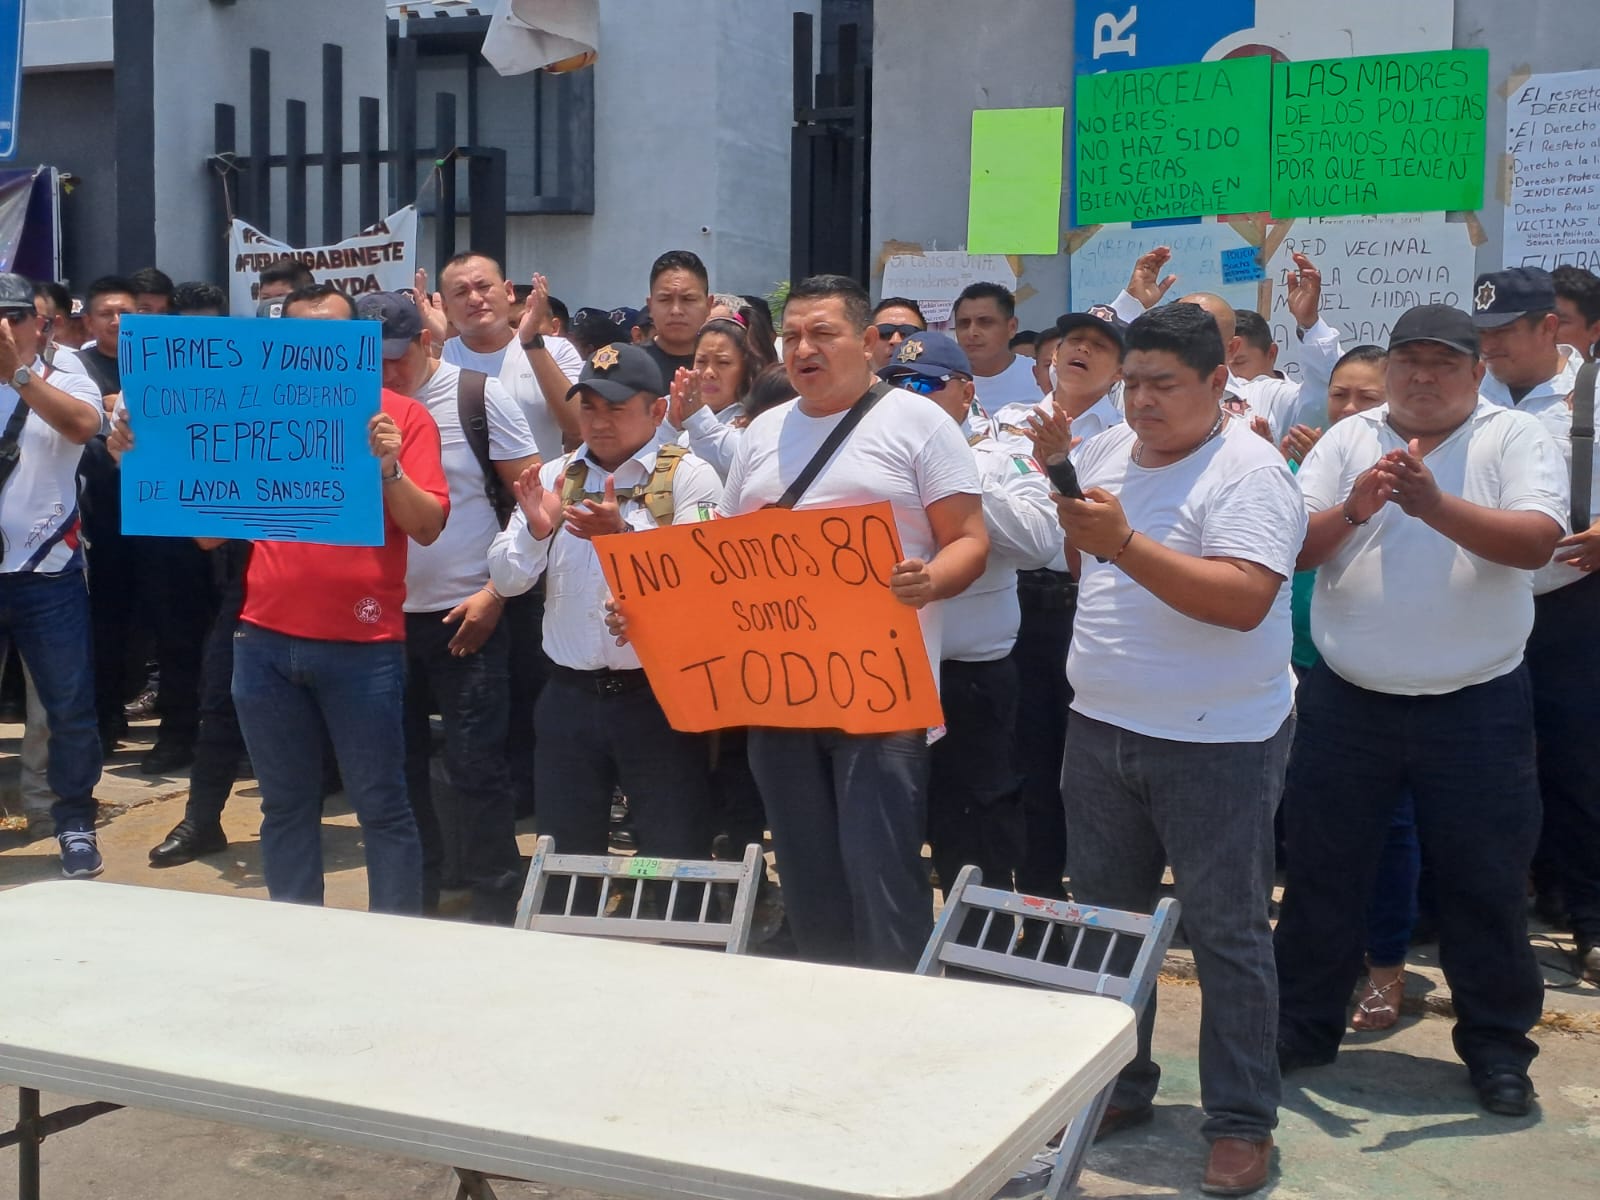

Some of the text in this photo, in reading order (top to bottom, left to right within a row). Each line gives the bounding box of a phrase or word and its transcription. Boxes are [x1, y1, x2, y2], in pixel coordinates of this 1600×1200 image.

[1094, 68, 1233, 110] MARCELA
[1285, 60, 1469, 99] LAS MADRES
[1285, 93, 1485, 126] DE LOS POLICIAS
[1077, 116, 1107, 136] NO
[1544, 119, 1597, 135] Derecho
[1080, 126, 1240, 160] NO HAZ SIDO
[1276, 127, 1477, 157] ESTAMOS AQUI
[1080, 157, 1187, 188] NI SERAS
[1276, 155, 1468, 181] POR QUE TIENEN
[1578, 154, 1588, 165] la
[1079, 176, 1241, 212] BIENVENIDA EN
[1287, 181, 1379, 209] MUCHA
[1522, 185, 1596, 198] INDIGENAS
[1133, 195, 1229, 219] CAMPECHE
[1514, 203, 1557, 216] Derecho
[1516, 217, 1590, 232] VICTIMAS
[1283, 237, 1433, 257] RED VECINAL
[1356, 265, 1450, 285] COLONIA
[262, 340, 274, 371] Y
[142, 383, 357, 418] CONTRA EL GOBIERNO
[138, 478, 345, 503] DE LAYDA SANSORES
[820, 514, 906, 589] 80
